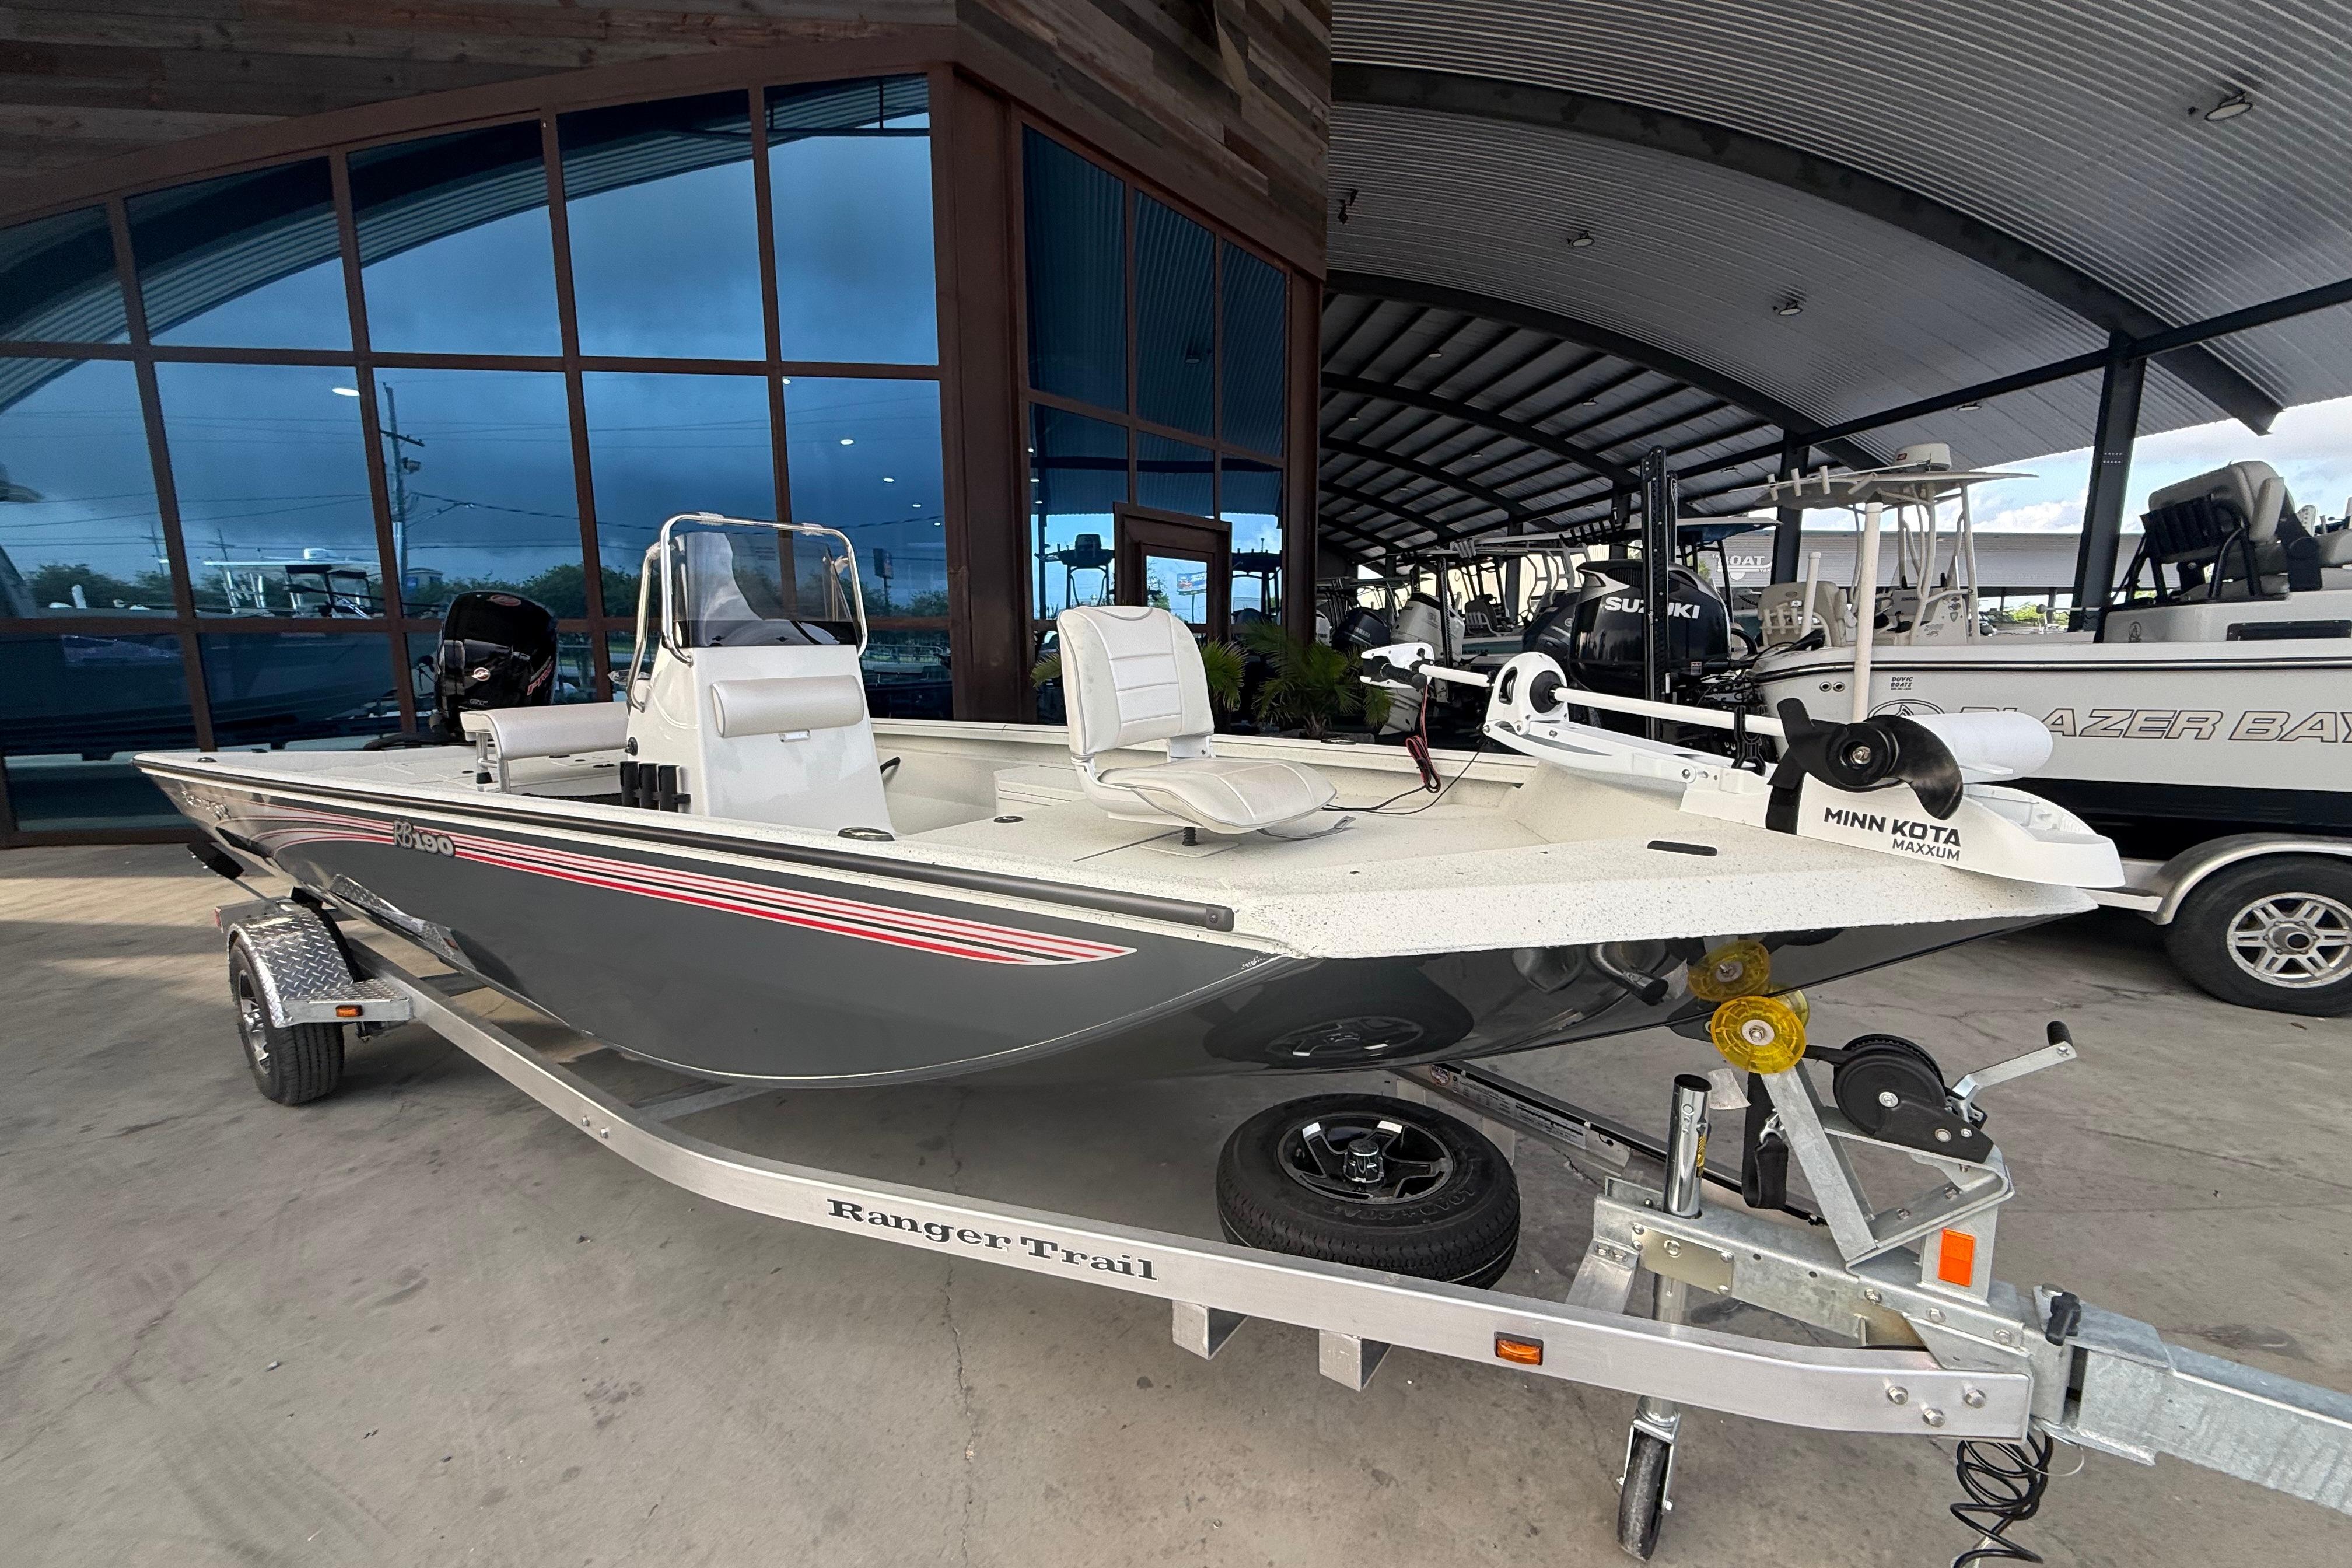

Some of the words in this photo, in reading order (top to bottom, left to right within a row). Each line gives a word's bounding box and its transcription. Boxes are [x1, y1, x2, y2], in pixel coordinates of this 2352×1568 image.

[1959, 706, 2223, 740] AZER
[1824, 807, 1887, 833] MINN
[1891, 818, 1961, 847] KOTA
[1892, 838, 1961, 862] MAXXUM
[826, 1198, 1013, 1251] Ranger
[1019, 1235, 1160, 1282] Trail
